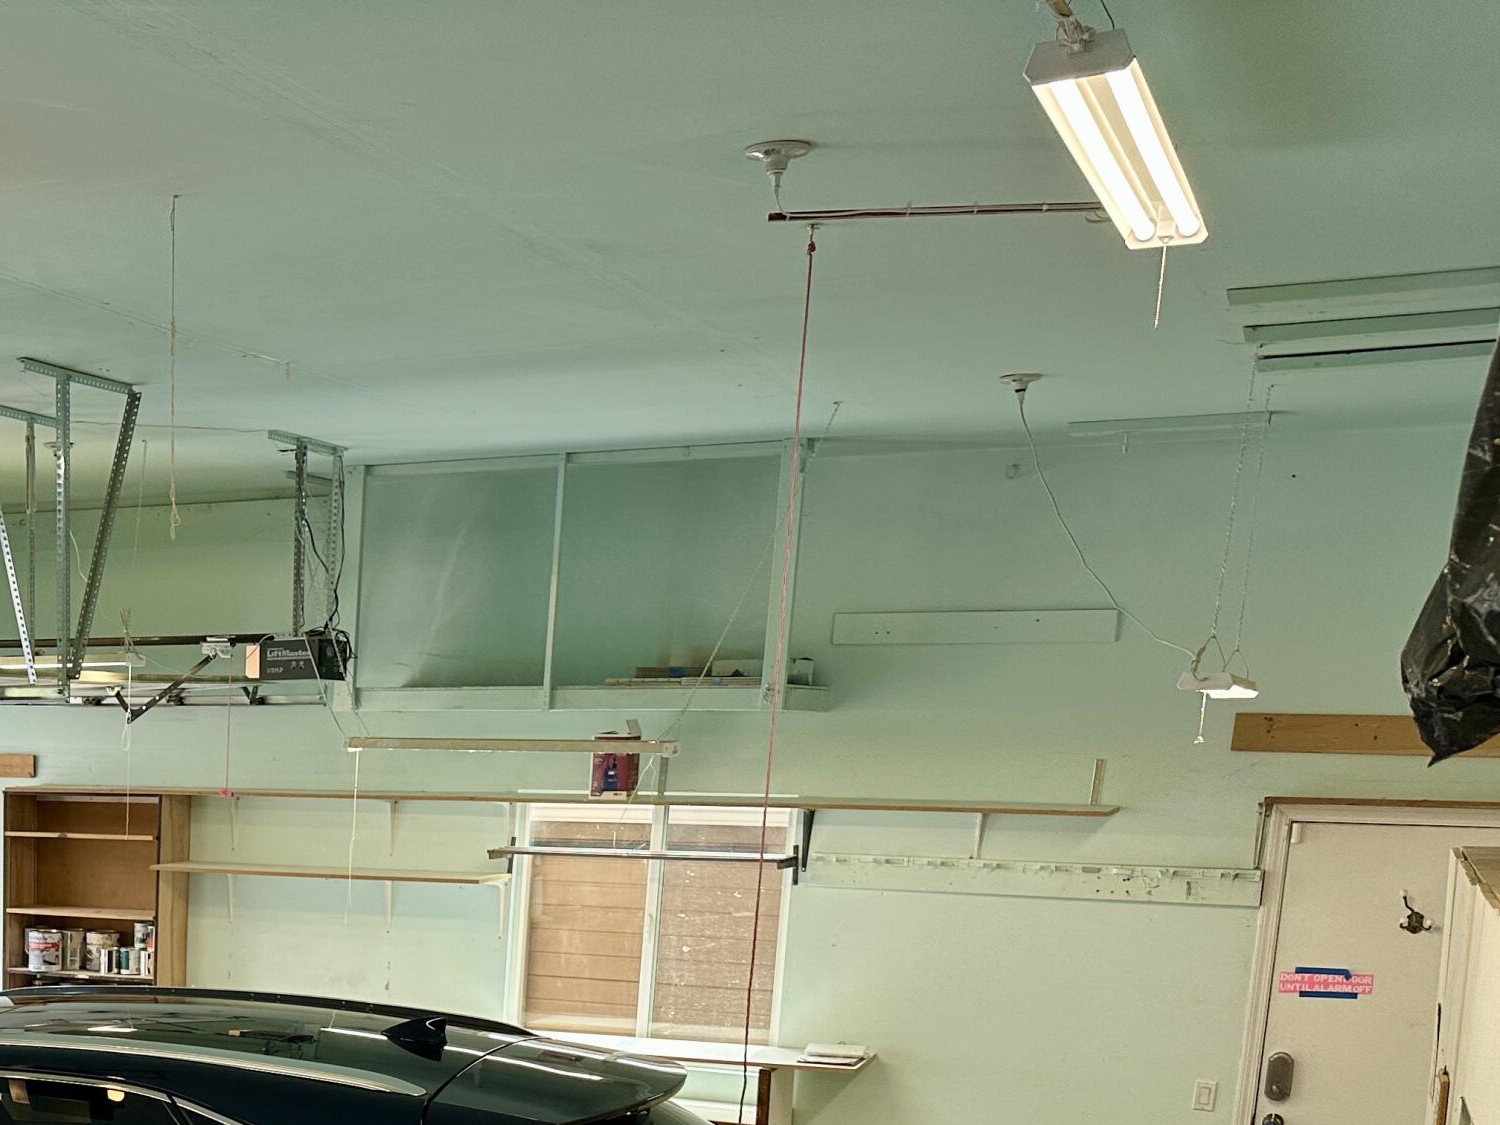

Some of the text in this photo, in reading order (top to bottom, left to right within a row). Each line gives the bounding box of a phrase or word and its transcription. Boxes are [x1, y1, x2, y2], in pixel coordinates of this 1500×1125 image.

[1313, 974, 1344, 983] OPEN
[1280, 982, 1373, 993] UNTIL ALARM OFF
